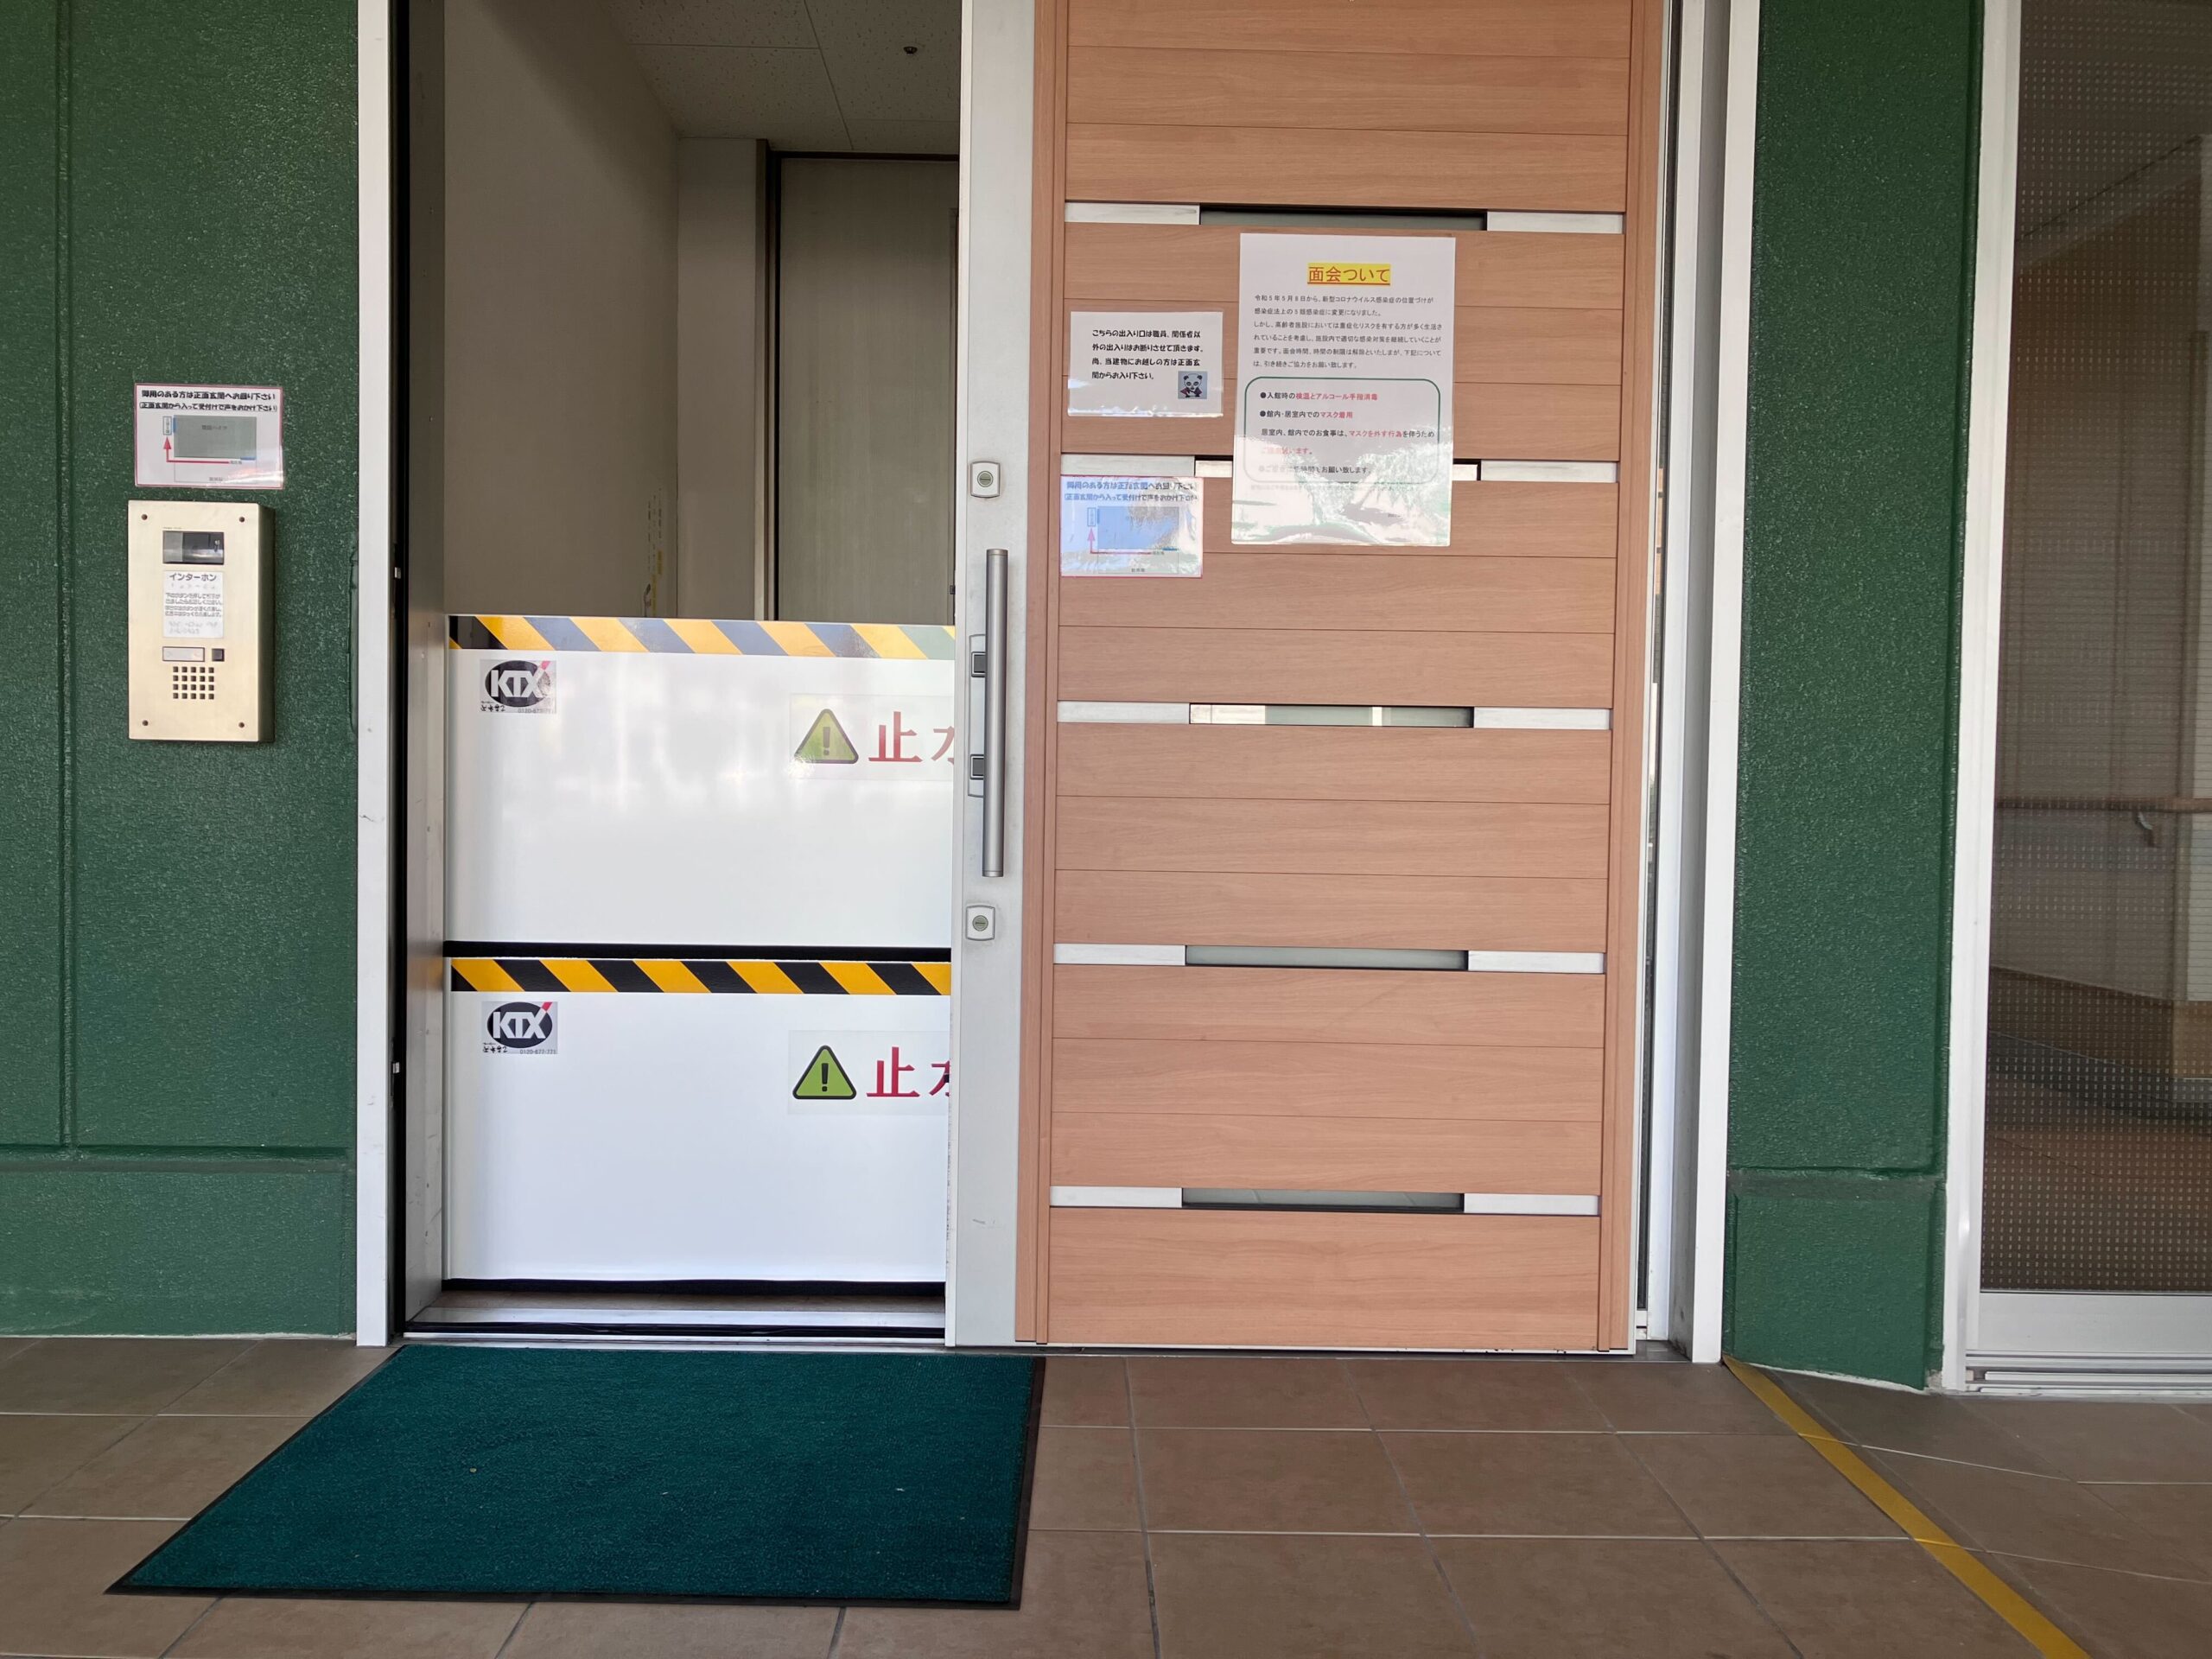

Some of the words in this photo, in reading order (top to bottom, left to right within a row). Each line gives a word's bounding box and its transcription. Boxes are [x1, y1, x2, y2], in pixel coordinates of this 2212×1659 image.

[1307, 266, 1390, 283] 面会ついて
[168, 572, 218, 582] インターホン
[490, 660, 551, 698] KTX
[492, 1001, 553, 1039] KTX
